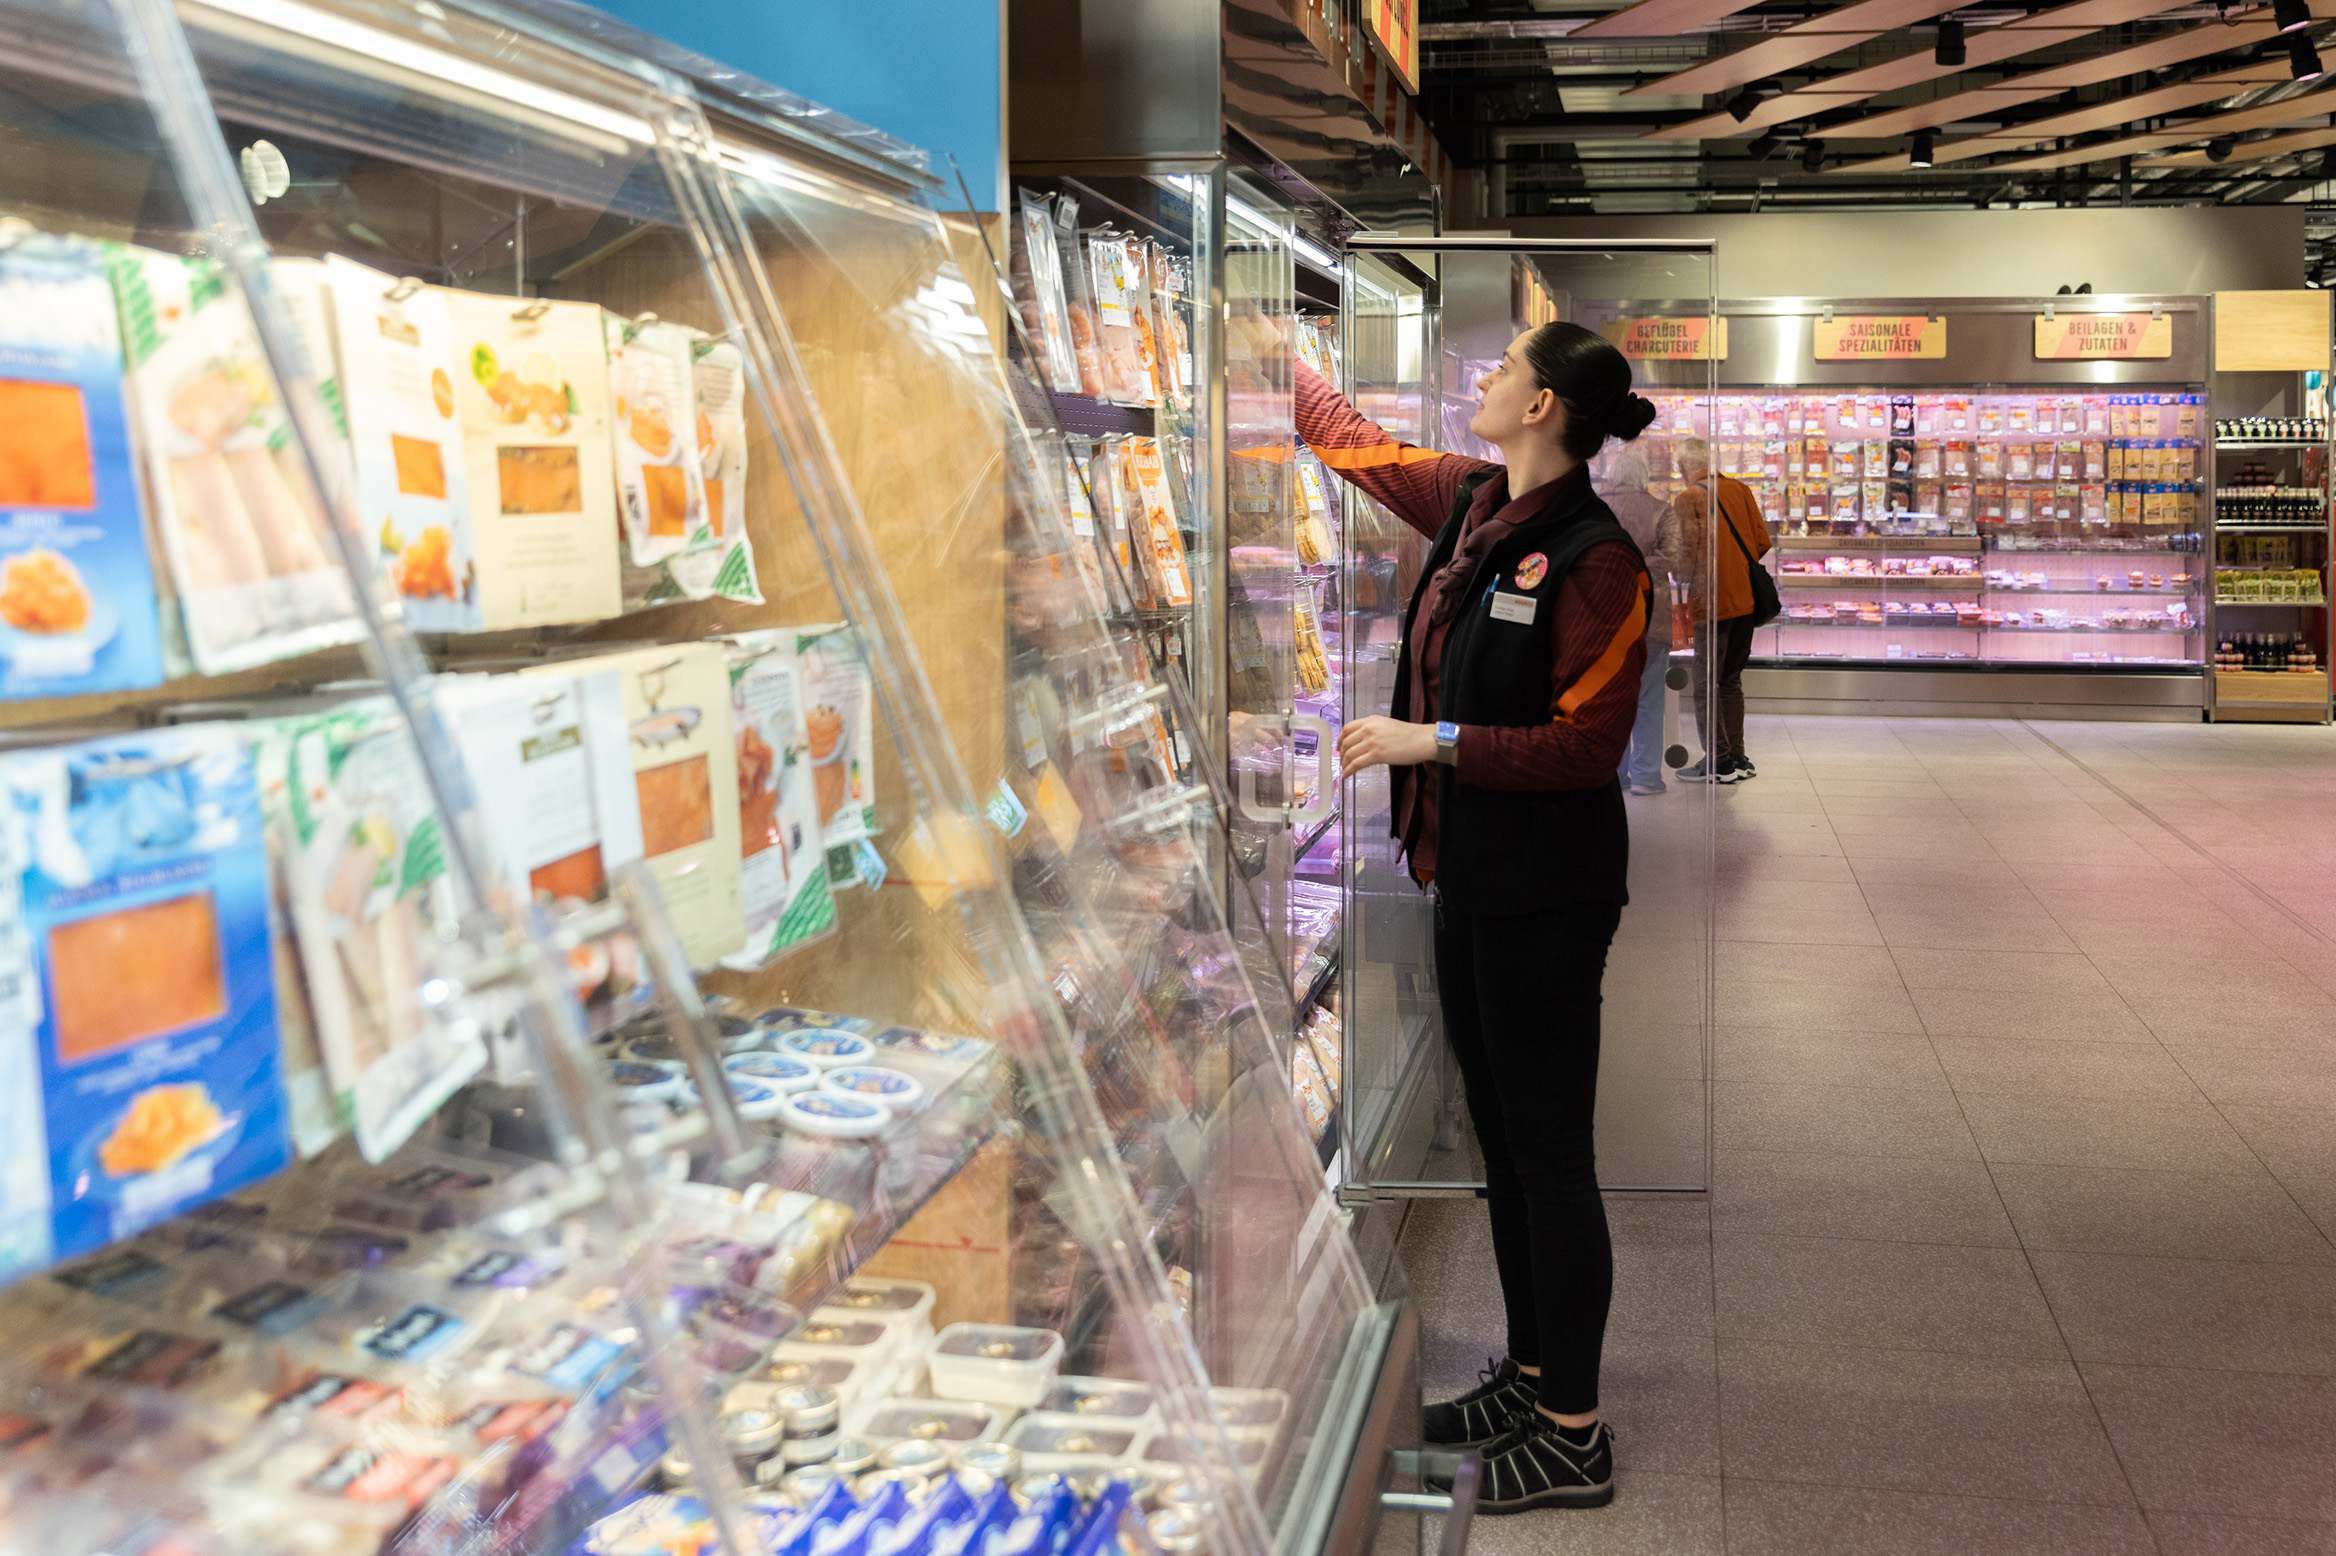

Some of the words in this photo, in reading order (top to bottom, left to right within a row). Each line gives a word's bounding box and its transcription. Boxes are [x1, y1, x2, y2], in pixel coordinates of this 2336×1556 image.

[1637, 322, 1688, 338] GEFLÜGEL
[1850, 323, 1911, 337] SAISONALE
[2069, 322, 2123, 335] BEILAGEN
[2128, 321, 2137, 334] &
[1626, 340, 1699, 353] CHARCUTERIE
[1839, 337, 1922, 352] SPEZIALITÄTEN
[2079, 337, 2128, 351] ZUTATEN
[1134, 453, 1160, 469] KEBAB
